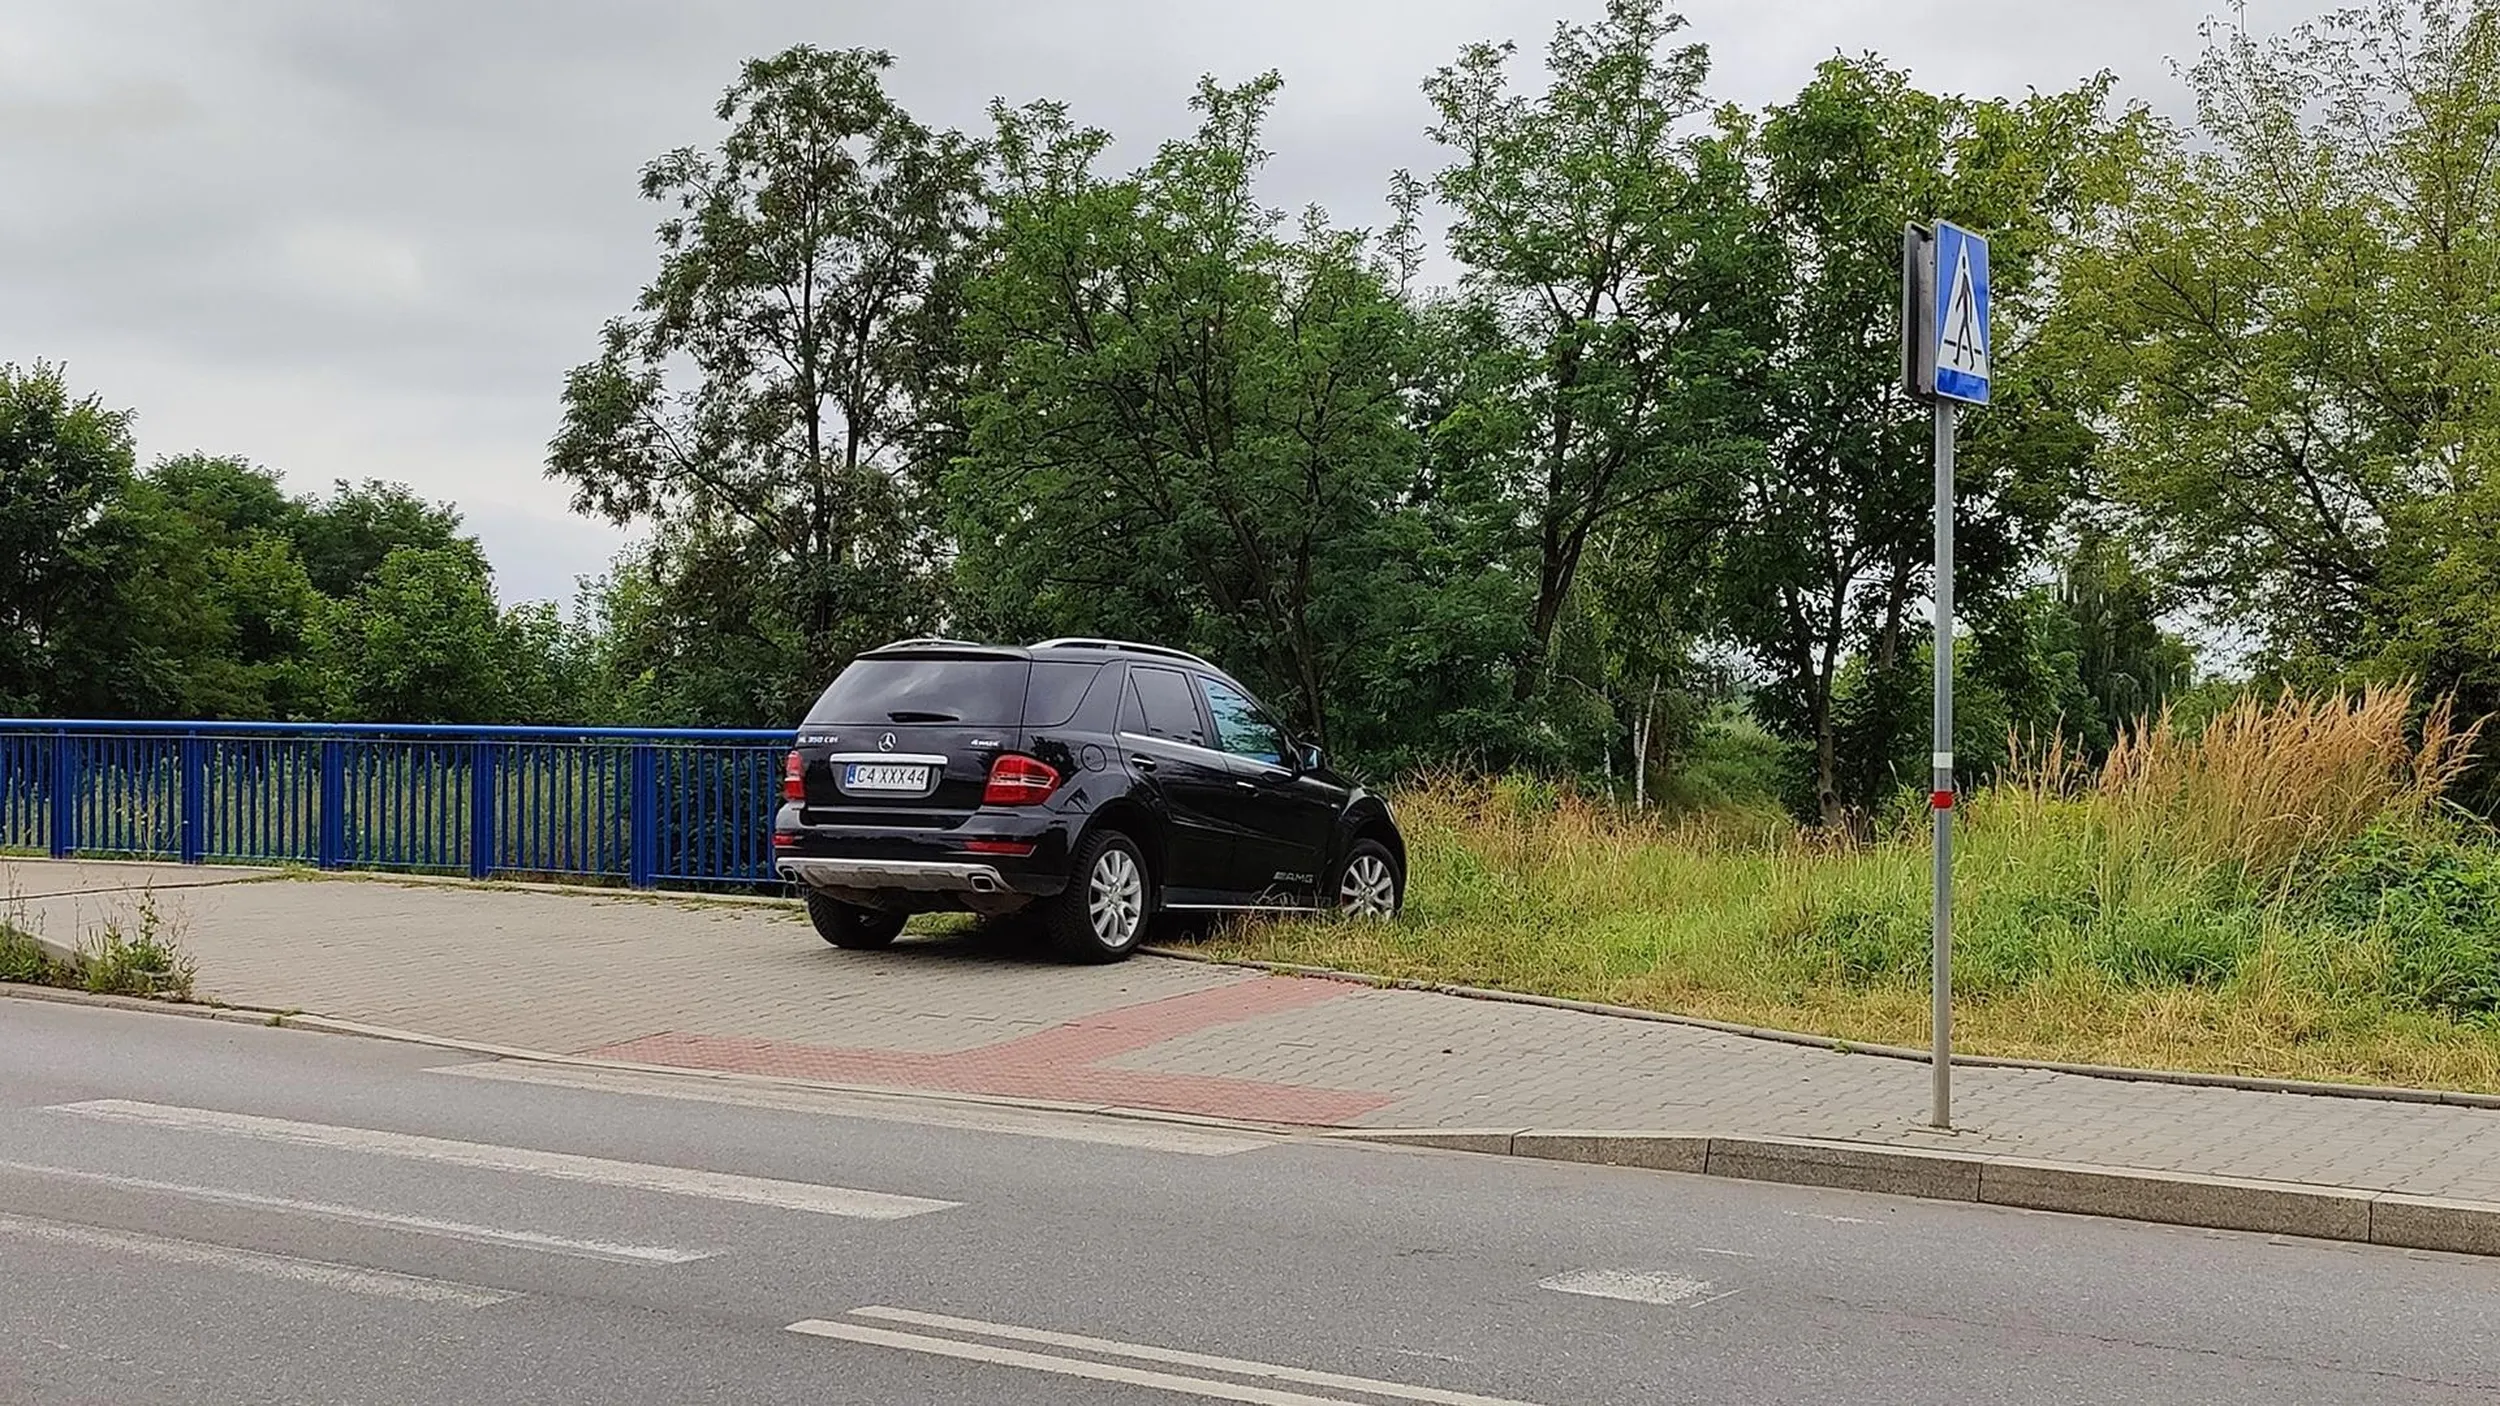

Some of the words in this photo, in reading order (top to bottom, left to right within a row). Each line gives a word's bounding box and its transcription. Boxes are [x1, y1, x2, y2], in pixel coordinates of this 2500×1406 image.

[857, 767, 876, 783] C4
[879, 768, 926, 784] XXX44
[1285, 872, 1314, 883] AMG
